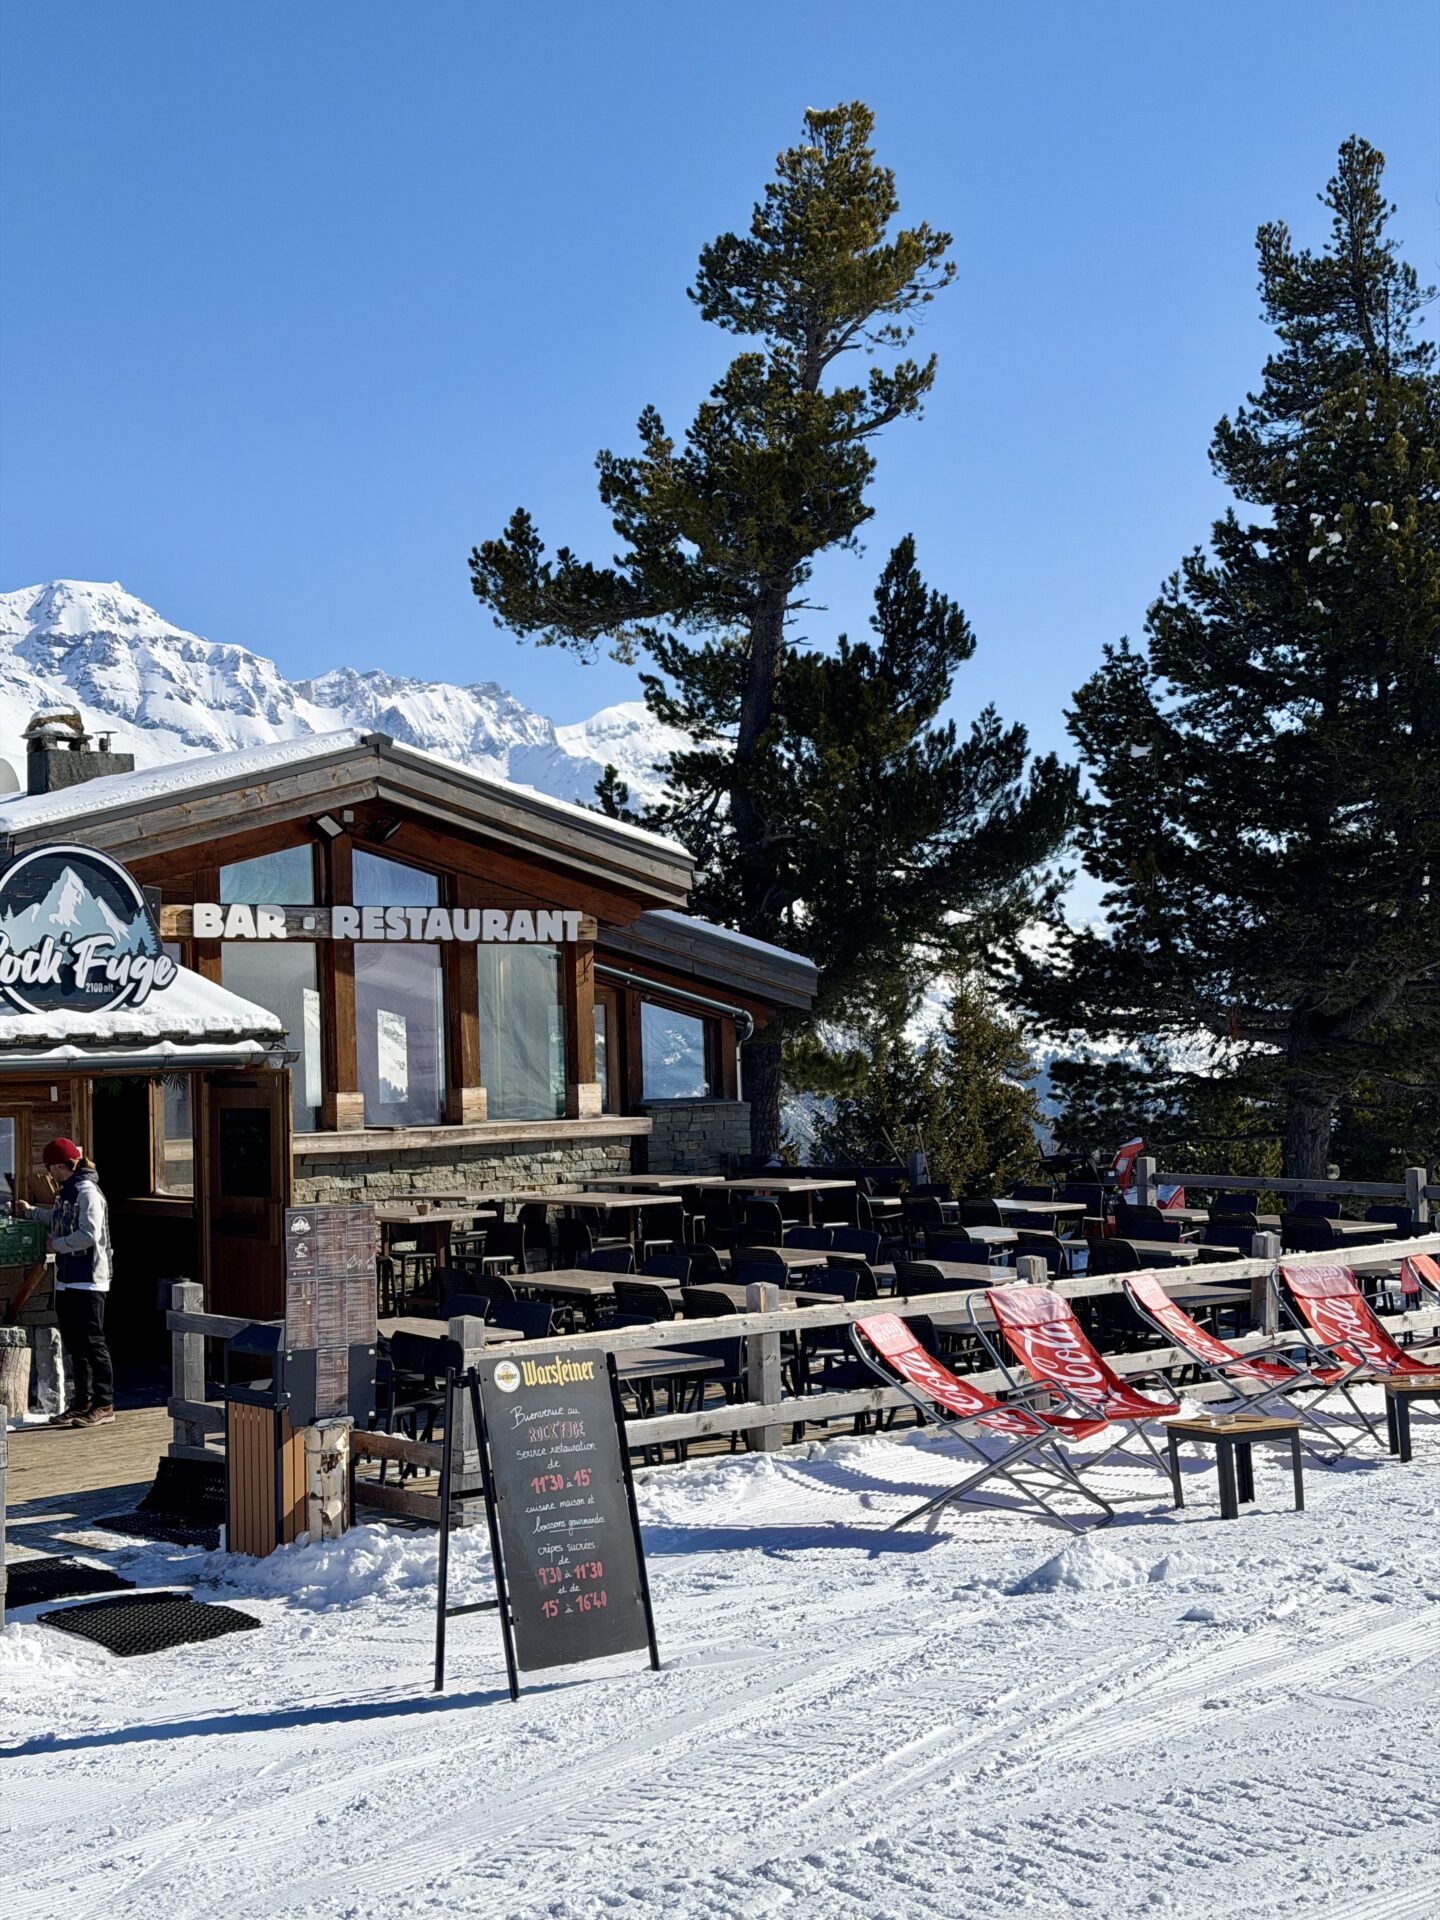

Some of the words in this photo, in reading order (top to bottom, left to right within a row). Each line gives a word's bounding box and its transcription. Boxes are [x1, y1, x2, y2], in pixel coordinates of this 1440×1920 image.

[193, 903, 287, 939] BAR
[331, 905, 583, 942] RESTAURANT
[85, 982, 103, 993] 2100
[521, 1355, 595, 1386] Warsteiner
[510, 1405, 564, 1430] Bienvenue
[567, 1407, 580, 1415] au
[549, 1440, 597, 1454] restauration
[546, 1458, 561, 1469] de
[566, 1476, 574, 1488] à
[525, 1502, 557, 1514] cuisine
[559, 1497, 585, 1508] maison
[587, 1493, 595, 1504] et
[532, 1516, 566, 1534] boissons
[568, 1512, 605, 1536] gourmandes
[537, 1543, 563, 1563] crêpes
[567, 1539, 596, 1552] sucrées
[557, 1555, 571, 1565] de
[564, 1570, 573, 1579] à
[557, 1585, 567, 1594] et
[569, 1582, 581, 1592] de
[565, 1603, 574, 1613] à
